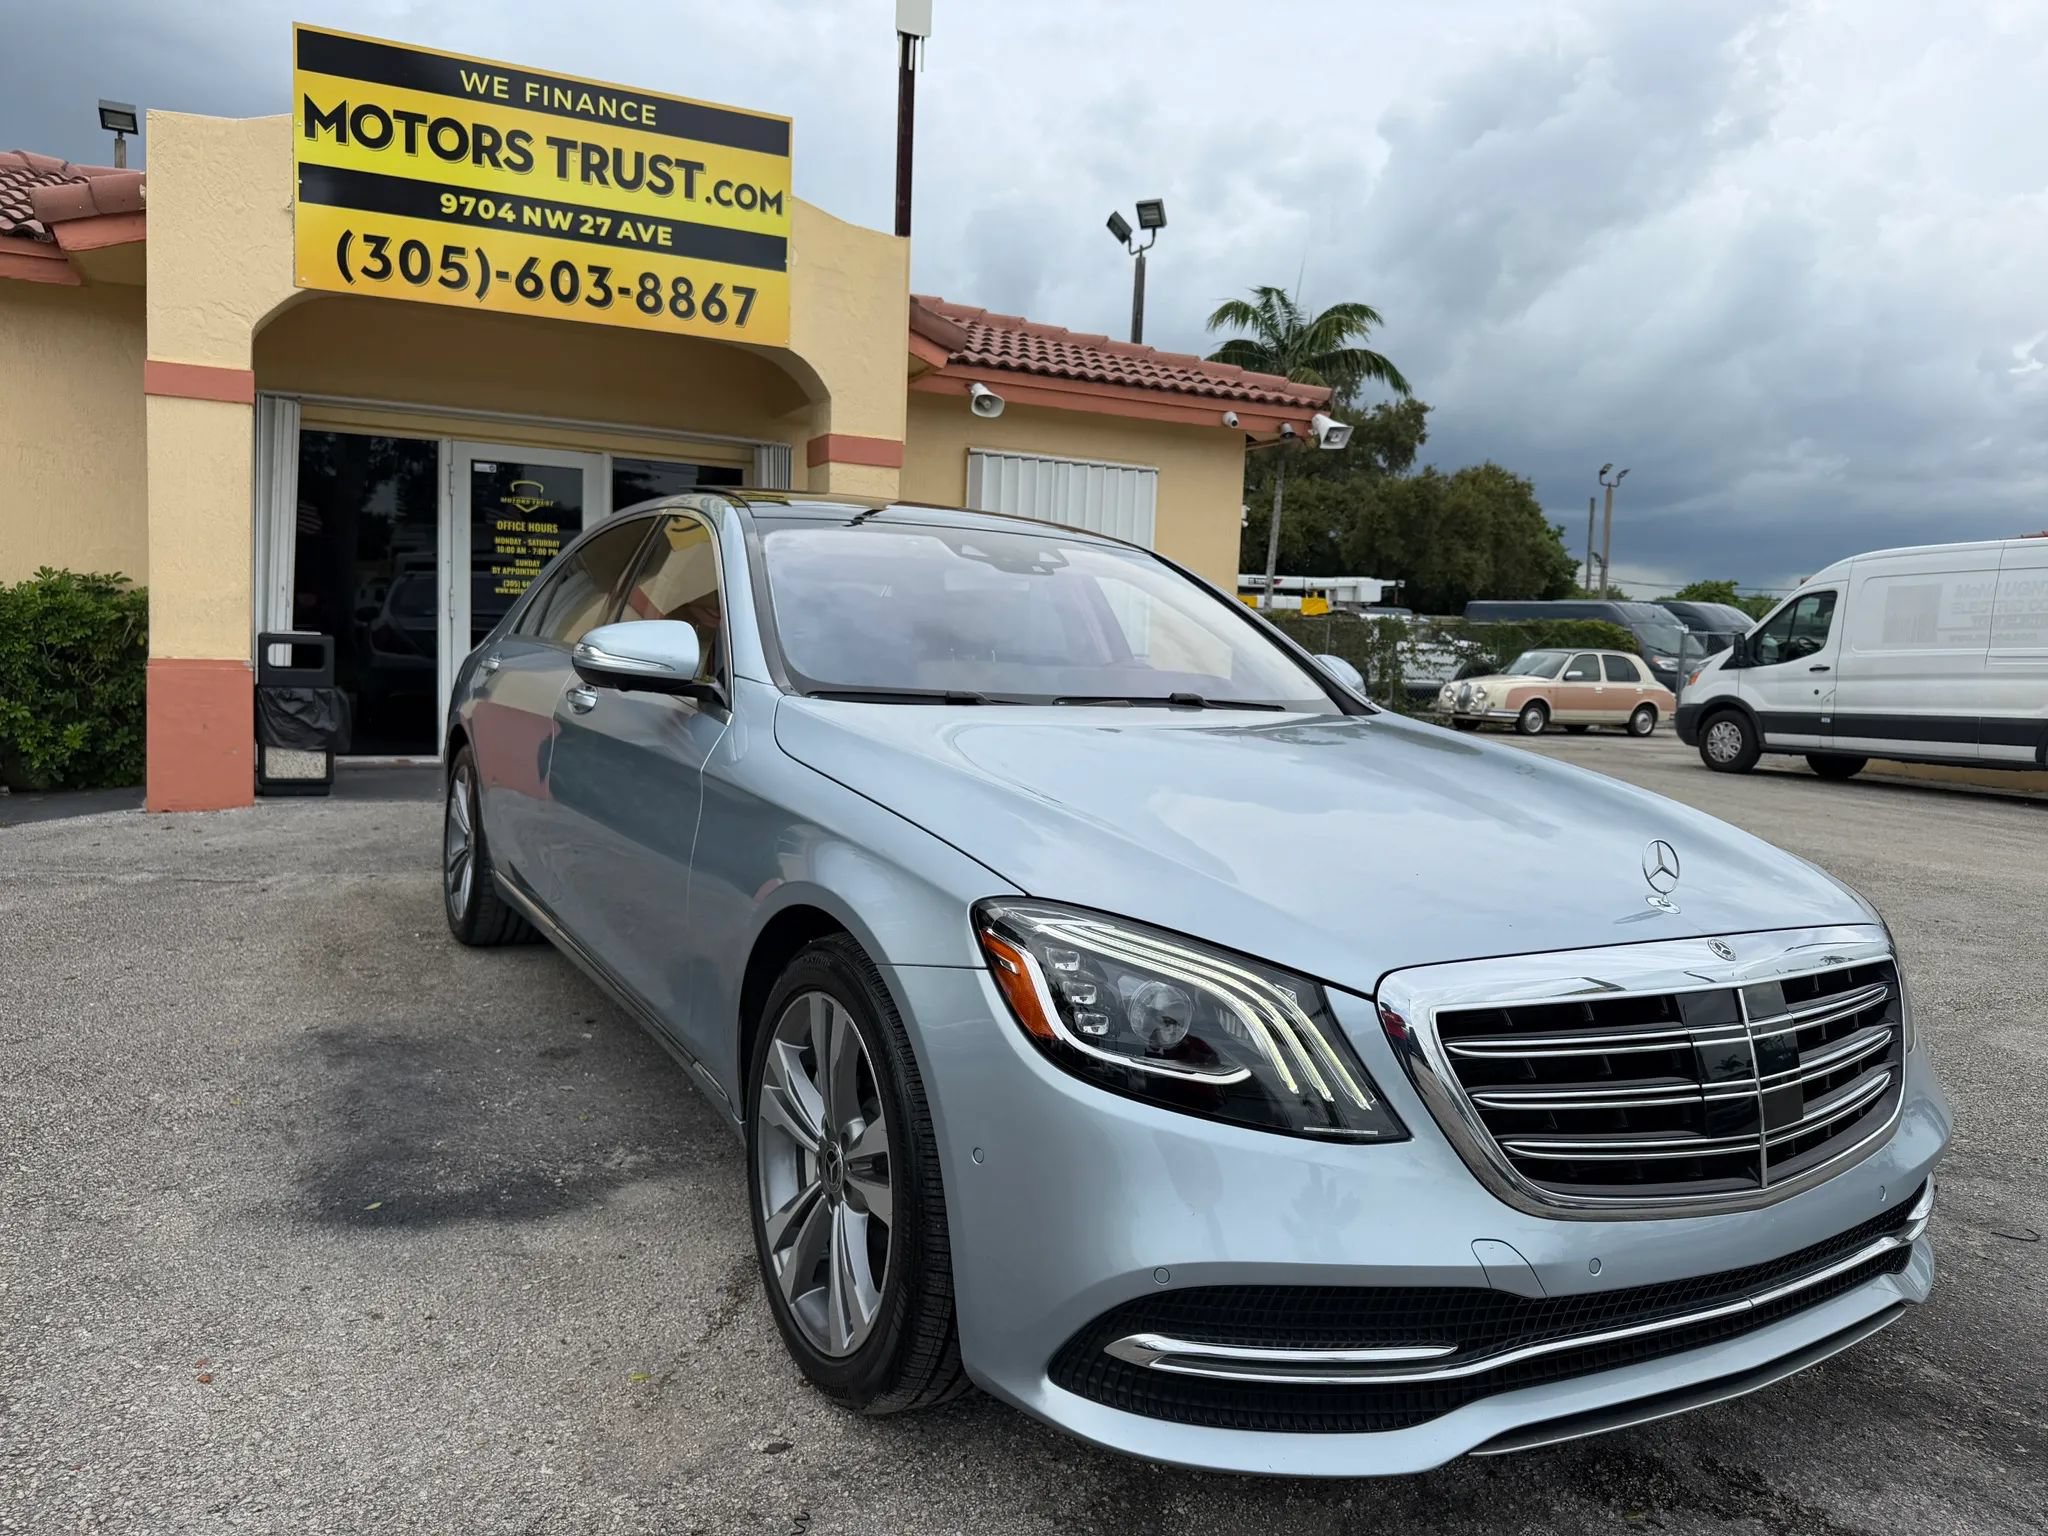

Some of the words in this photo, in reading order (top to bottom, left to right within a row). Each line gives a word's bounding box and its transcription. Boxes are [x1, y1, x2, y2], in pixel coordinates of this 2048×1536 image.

[460, 69, 510, 100] WE
[525, 82, 657, 127] FINANCE
[303, 92, 534, 175] MOTORS
[440, 192, 517, 224] 9704
[523, 201, 574, 233] NW
[579, 212, 613, 238] 27
[616, 219, 673, 247] AVE
[336, 228, 758, 328] (305)-603-8867
[496, 521, 526, 532] OFFICE
[528, 522, 558, 534] HOURS
[495, 536, 521, 546] MONDAY
[528, 538, 560, 548] SATURDAY
[497, 545, 515, 554] 10:00
[516, 546, 526, 555] AM
[533, 547, 547, 556] 7:00
[548, 548, 559, 557] PM
[515, 559, 540, 567] SUNDAY
[492, 566, 501, 574] BY
[502, 567, 541, 576] APPOINTME
